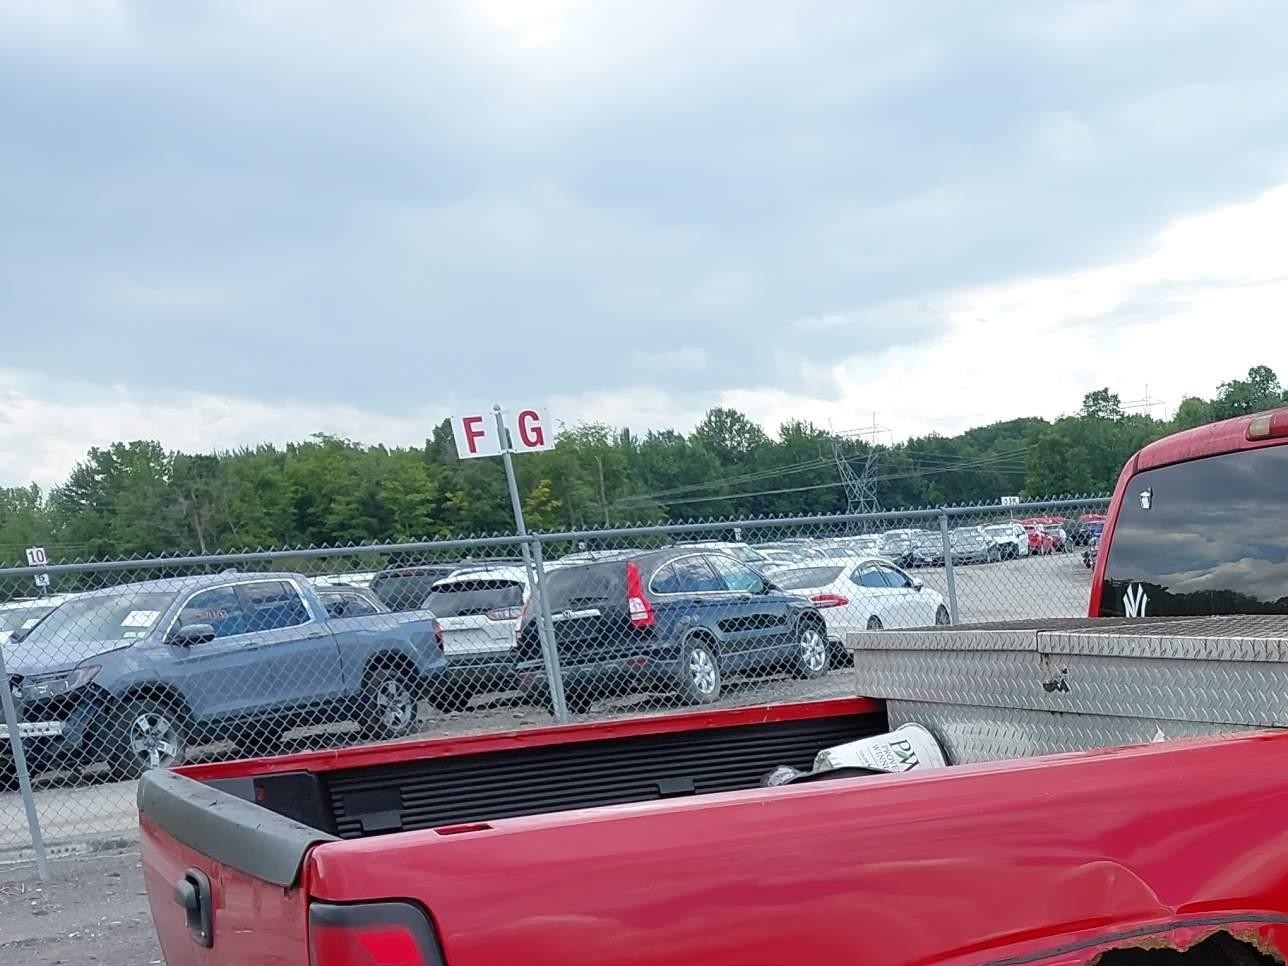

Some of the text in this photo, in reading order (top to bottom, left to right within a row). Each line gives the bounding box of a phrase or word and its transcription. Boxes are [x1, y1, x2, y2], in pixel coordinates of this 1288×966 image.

[462, 416, 485, 453] F
[518, 410, 545, 447] G
[28, 550, 45, 563] 10
